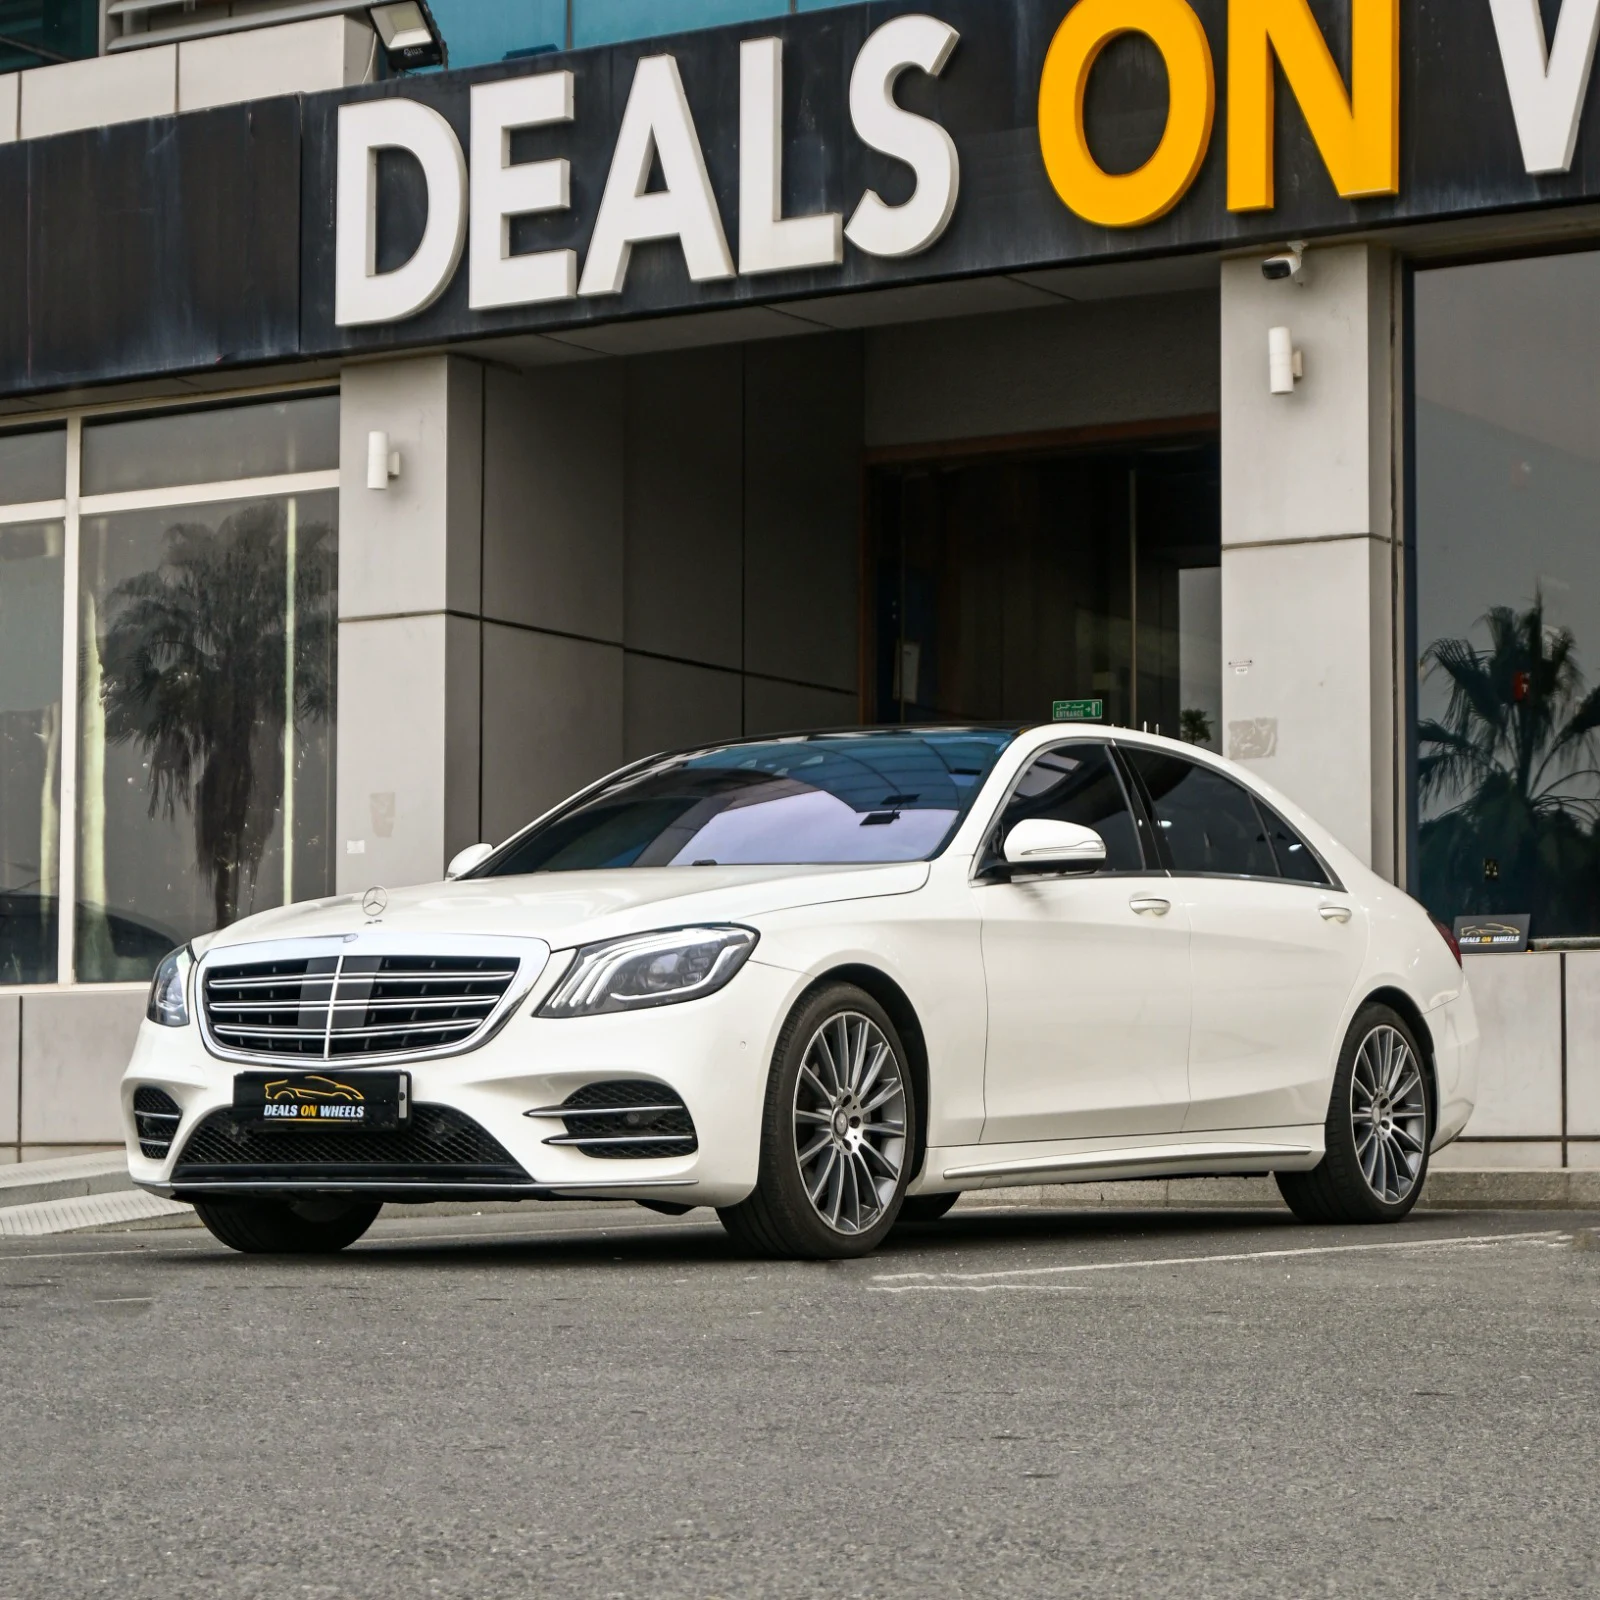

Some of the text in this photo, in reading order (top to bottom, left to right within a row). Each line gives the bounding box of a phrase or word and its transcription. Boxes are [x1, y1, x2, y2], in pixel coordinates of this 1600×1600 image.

[335, 14, 959, 326] DEALS
[1038, 0, 1400, 227] ON
[1056, 702, 1084, 711] مدخل
[1056, 710, 1084, 718] ENTRANCE
[263, 1104, 365, 1118] DEALS ON WHEELS
